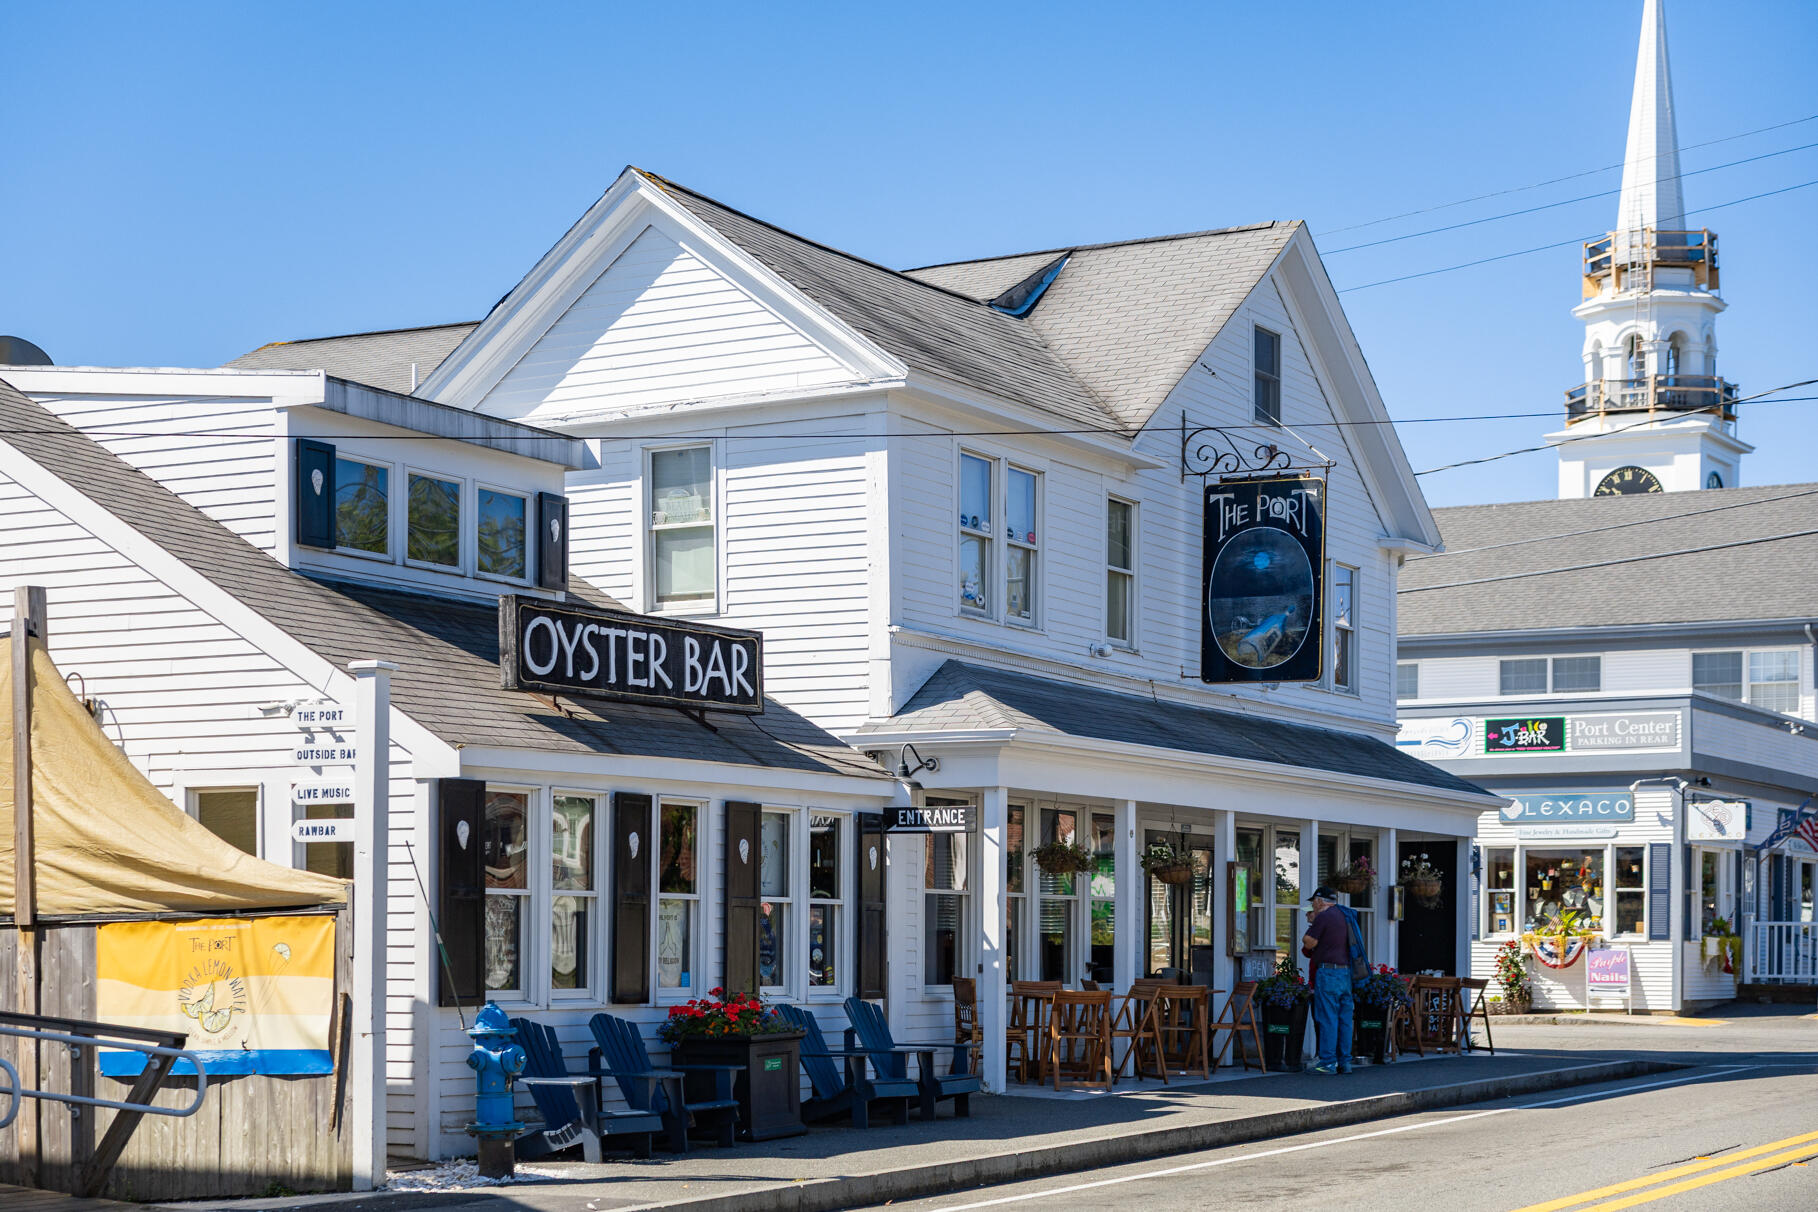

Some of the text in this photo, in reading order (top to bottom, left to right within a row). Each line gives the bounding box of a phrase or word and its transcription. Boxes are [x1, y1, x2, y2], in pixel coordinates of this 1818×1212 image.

[1209, 488, 1318, 543] THE PORT
[524, 615, 755, 697] OYSTER BAR
[297, 710, 343, 721] THE PORT
[1574, 718, 1674, 737] Port Center
[1577, 735, 1668, 746] PARKING IN REAR
[297, 749, 336, 760] OUTSIDE
[297, 788, 350, 799] LIVE MUSIC
[898, 807, 966, 825] ENTRANCE
[1525, 799, 1631, 816] LEXACO
[298, 826, 336, 836] RAWBAR
[188, 935, 237, 953] THE PORT
[1244, 959, 1267, 977] OPEN
[1590, 971, 1628, 983] Nails
[177, 958, 247, 1014] VODKA LEMON WATER
